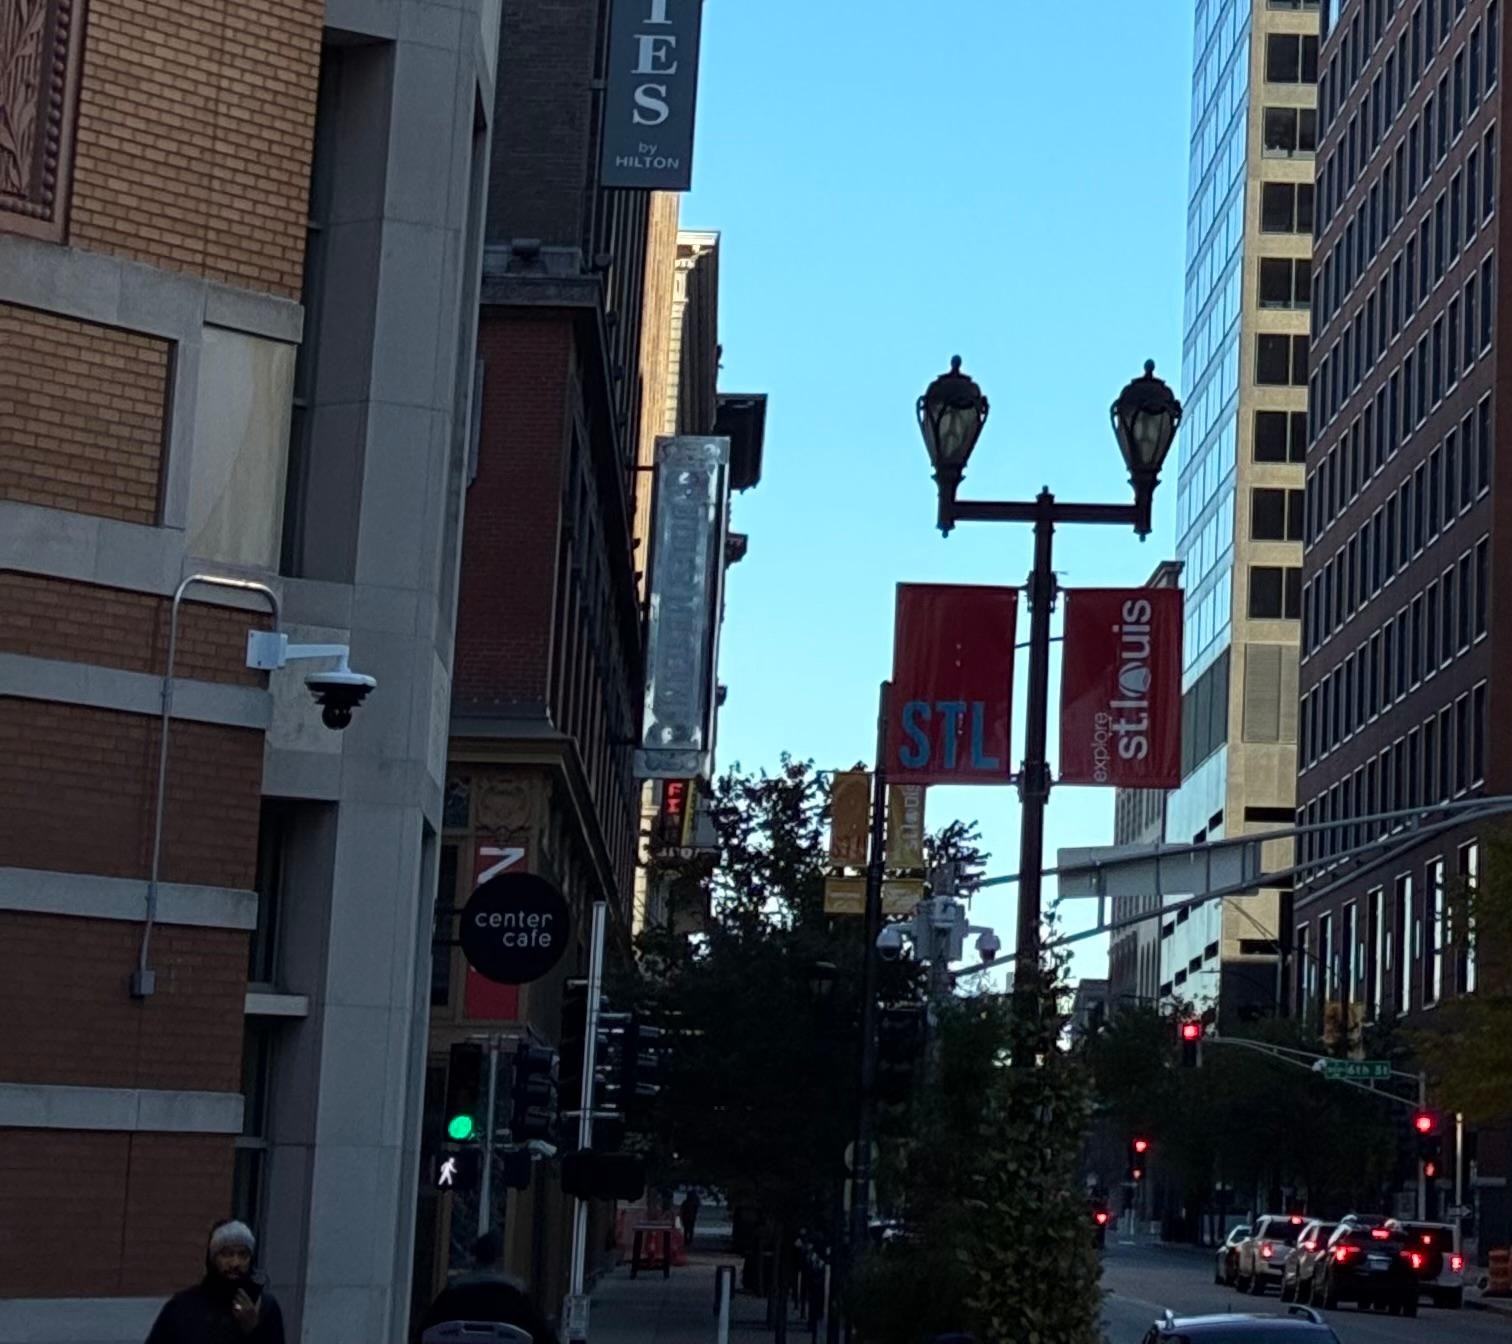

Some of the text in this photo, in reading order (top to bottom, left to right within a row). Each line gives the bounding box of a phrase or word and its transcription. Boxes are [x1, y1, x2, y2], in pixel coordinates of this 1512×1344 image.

[638, 141, 658, 157] by
[615, 155, 680, 170] HILTON
[897, 700, 1001, 770] STL
[1092, 711, 1110, 783] explore
[473, 910, 553, 928] center
[502, 929, 552, 947] cafe
